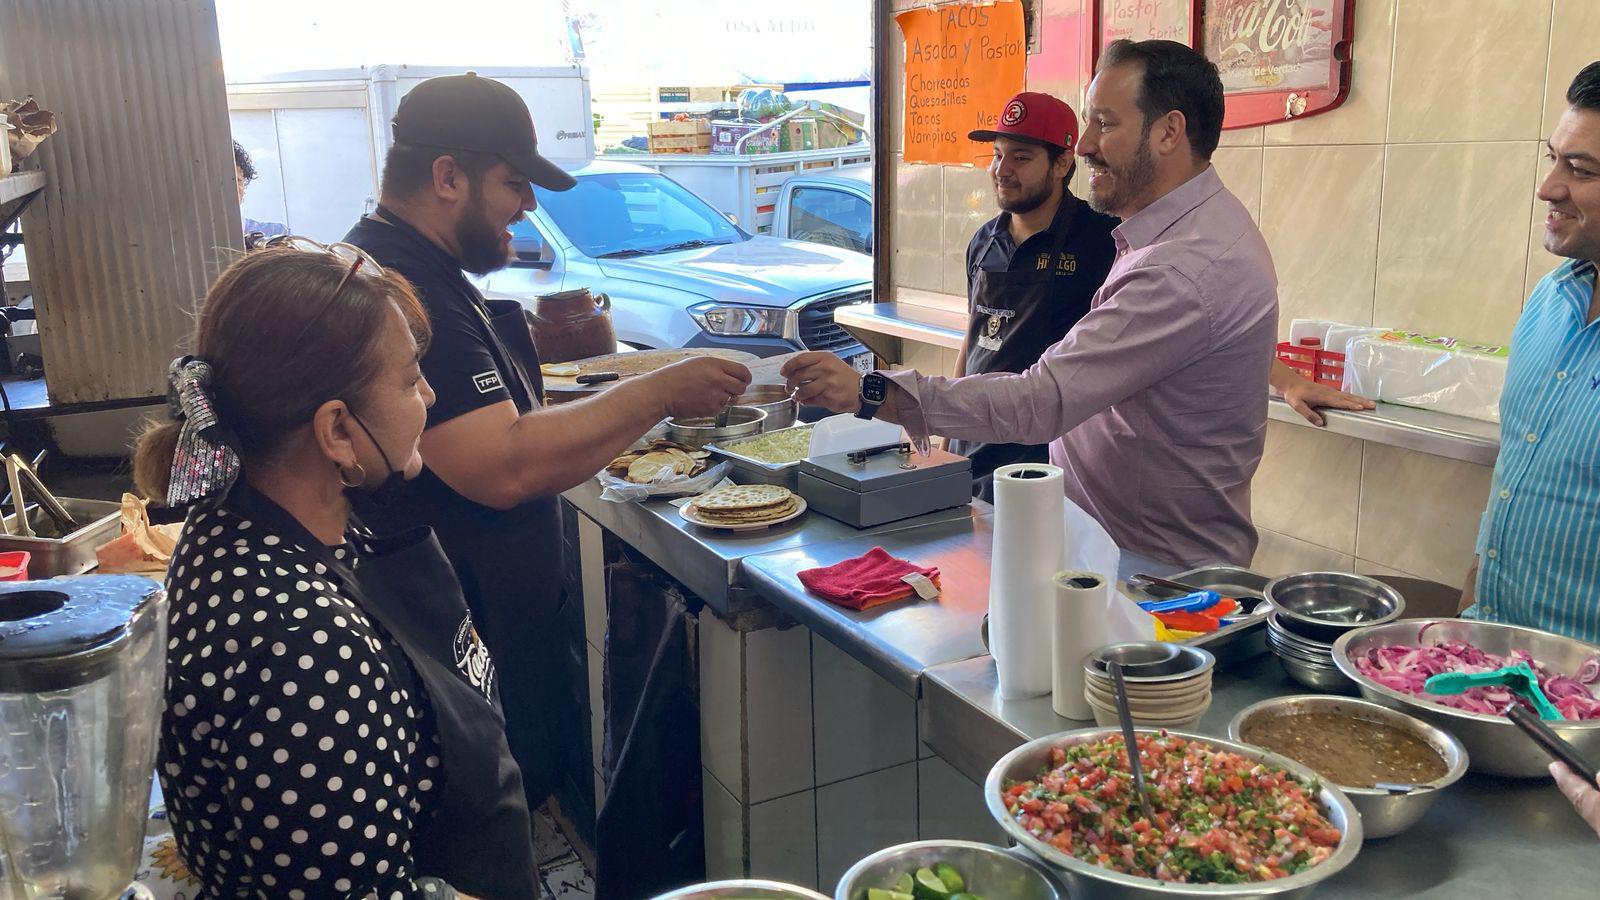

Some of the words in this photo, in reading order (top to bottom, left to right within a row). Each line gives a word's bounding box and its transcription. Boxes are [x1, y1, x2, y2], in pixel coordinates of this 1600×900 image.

[911, 36, 957, 63] Asada
[963, 39, 973, 64] y
[980, 32, 1023, 61] Pastor
[910, 68, 970, 92] Chorreadas
[910, 91, 967, 109] Quesadillas
[909, 111, 941, 127] Tacos
[909, 128, 957, 149] Vampiros
